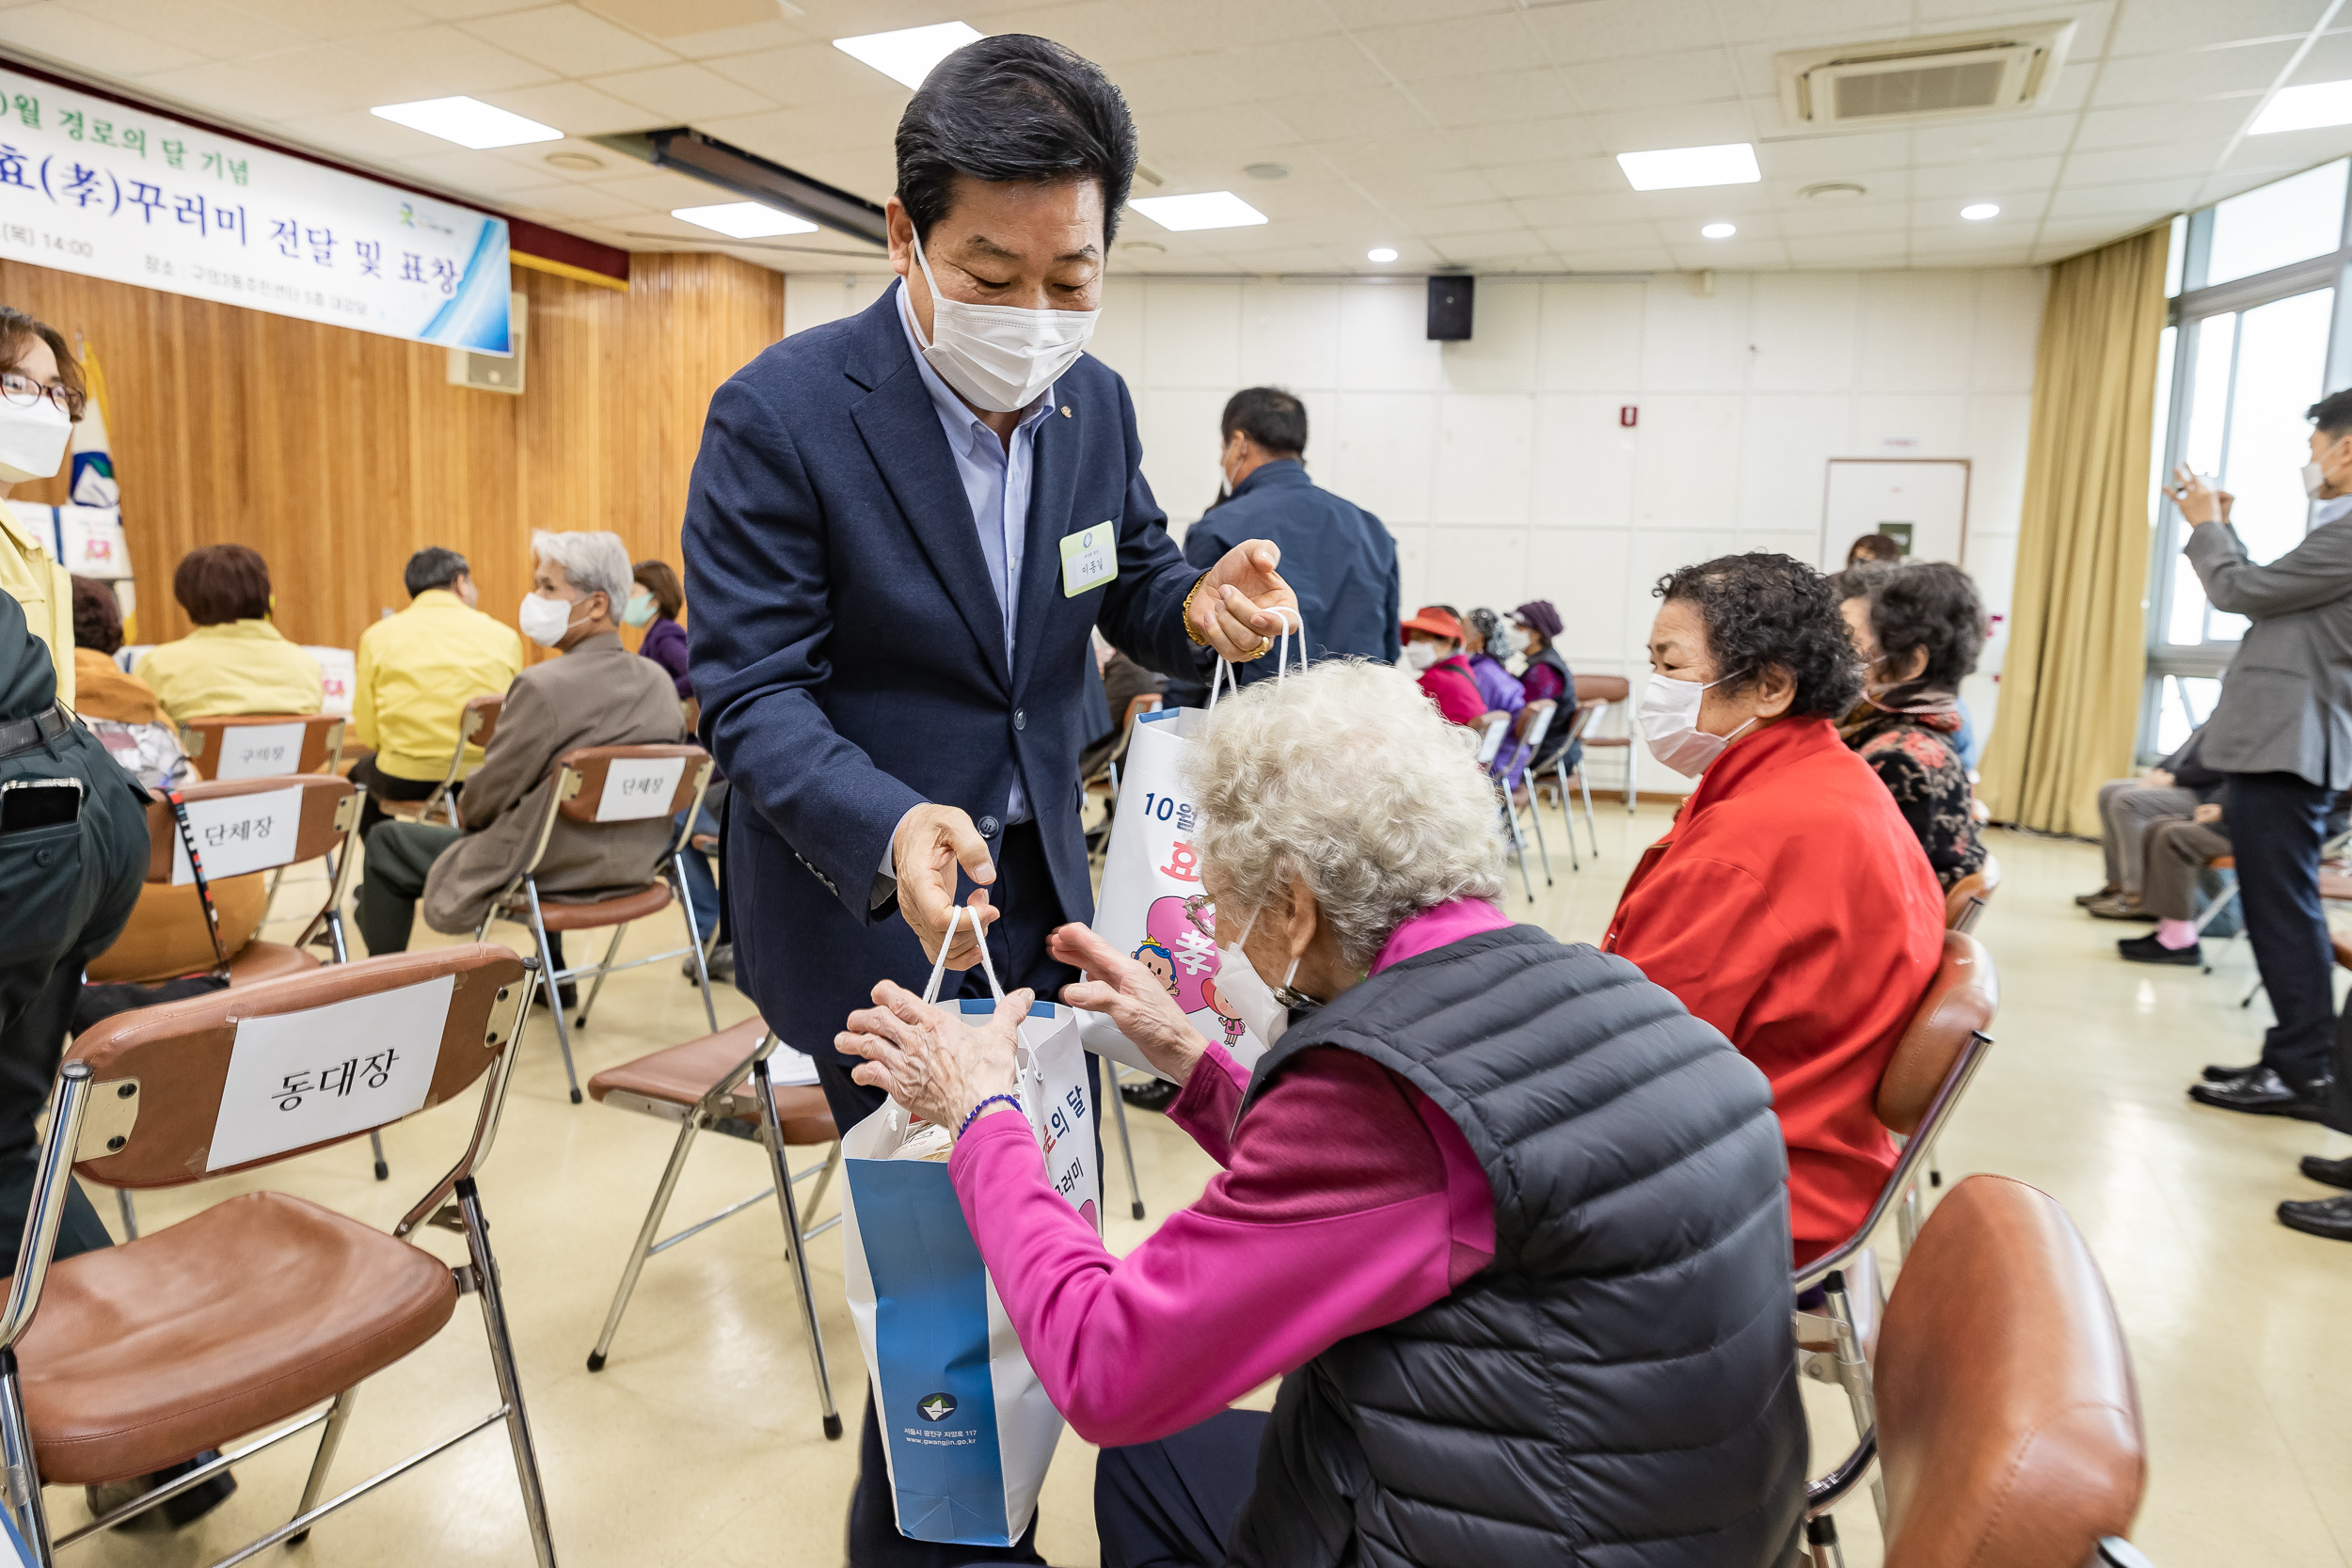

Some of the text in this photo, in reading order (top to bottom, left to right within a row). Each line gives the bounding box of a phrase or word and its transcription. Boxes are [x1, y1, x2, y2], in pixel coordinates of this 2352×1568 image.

[58, 109, 147, 159] 경로의
[161, 138, 187, 170] 달
[201, 150, 249, 187] 기념
[270, 219, 338, 267] 전달
[356, 241, 381, 278] 및
[400, 251, 458, 294] 표창
[623, 777, 663, 796] 단체장
[205, 816, 275, 847] 단체장
[1144, 793, 1198, 832] 10월
[1160, 841, 1200, 881] 효
[1173, 929, 1216, 975] 孝
[271, 1047, 400, 1112] 동대장
[1066, 1085, 1086, 1118] 달
[904, 1427, 922, 1435] 서울시
[924, 1430, 943, 1438] 광진구
[906, 1437, 976, 1447] www.gwangjin.go.kr
